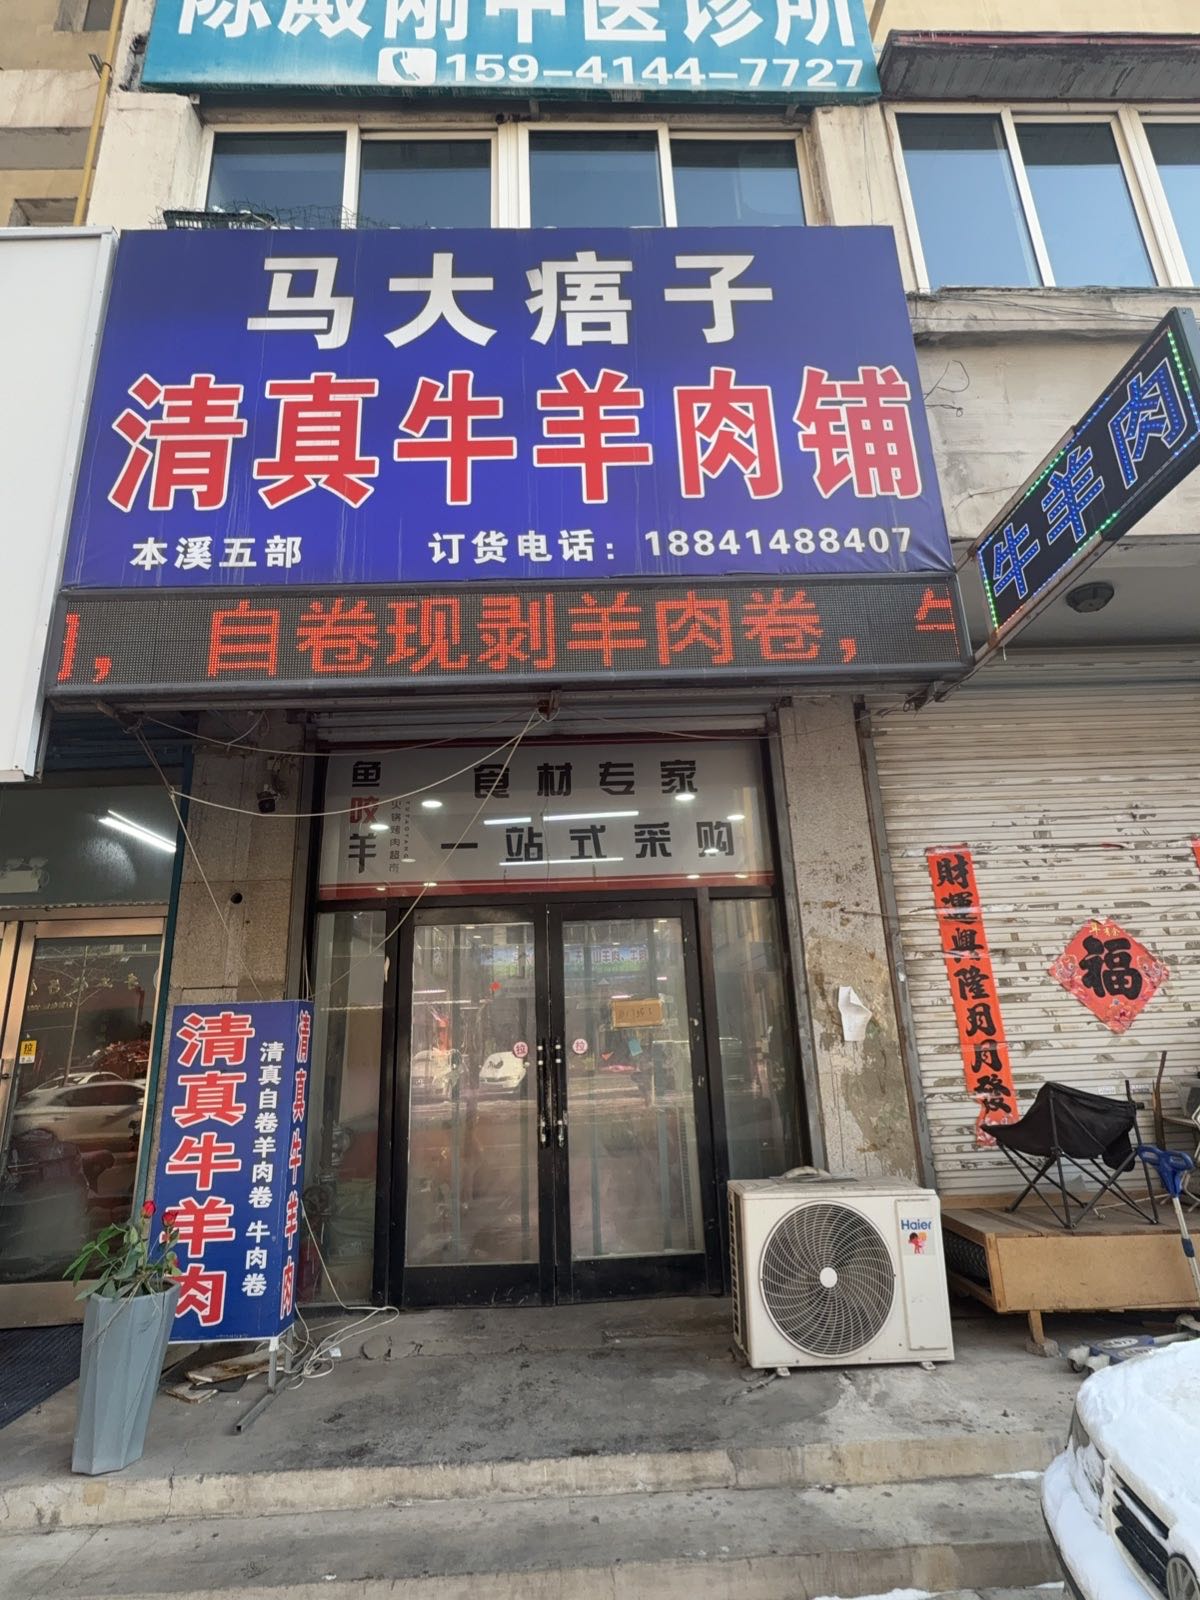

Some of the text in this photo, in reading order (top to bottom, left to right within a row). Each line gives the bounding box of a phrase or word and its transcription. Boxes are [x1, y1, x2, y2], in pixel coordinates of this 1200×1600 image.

[446, 54, 863, 88] 159-4144-7727
[247, 251, 773, 350] 马大痦子
[107, 364, 923, 512] 清真牛羊肉铺
[993, 358, 1188, 600] 牛羊肉
[130, 535, 302, 571] 本溪五部
[645, 526, 911, 557] 18841488407
[348, 761, 381, 874] 鱼咬羊
[474, 759, 698, 799] 食材专家
[441, 820, 735, 862] 一站式采购
[1079, 935, 1143, 999] 福
[161, 1011, 255, 1327] 清真牛羊肉
[241, 1041, 285, 1297] 清真自卷羊肉卷 牛肉卷
[280, 1010, 311, 1320] 清真牛羊肉
[901, 1218, 932, 1230] Haier
